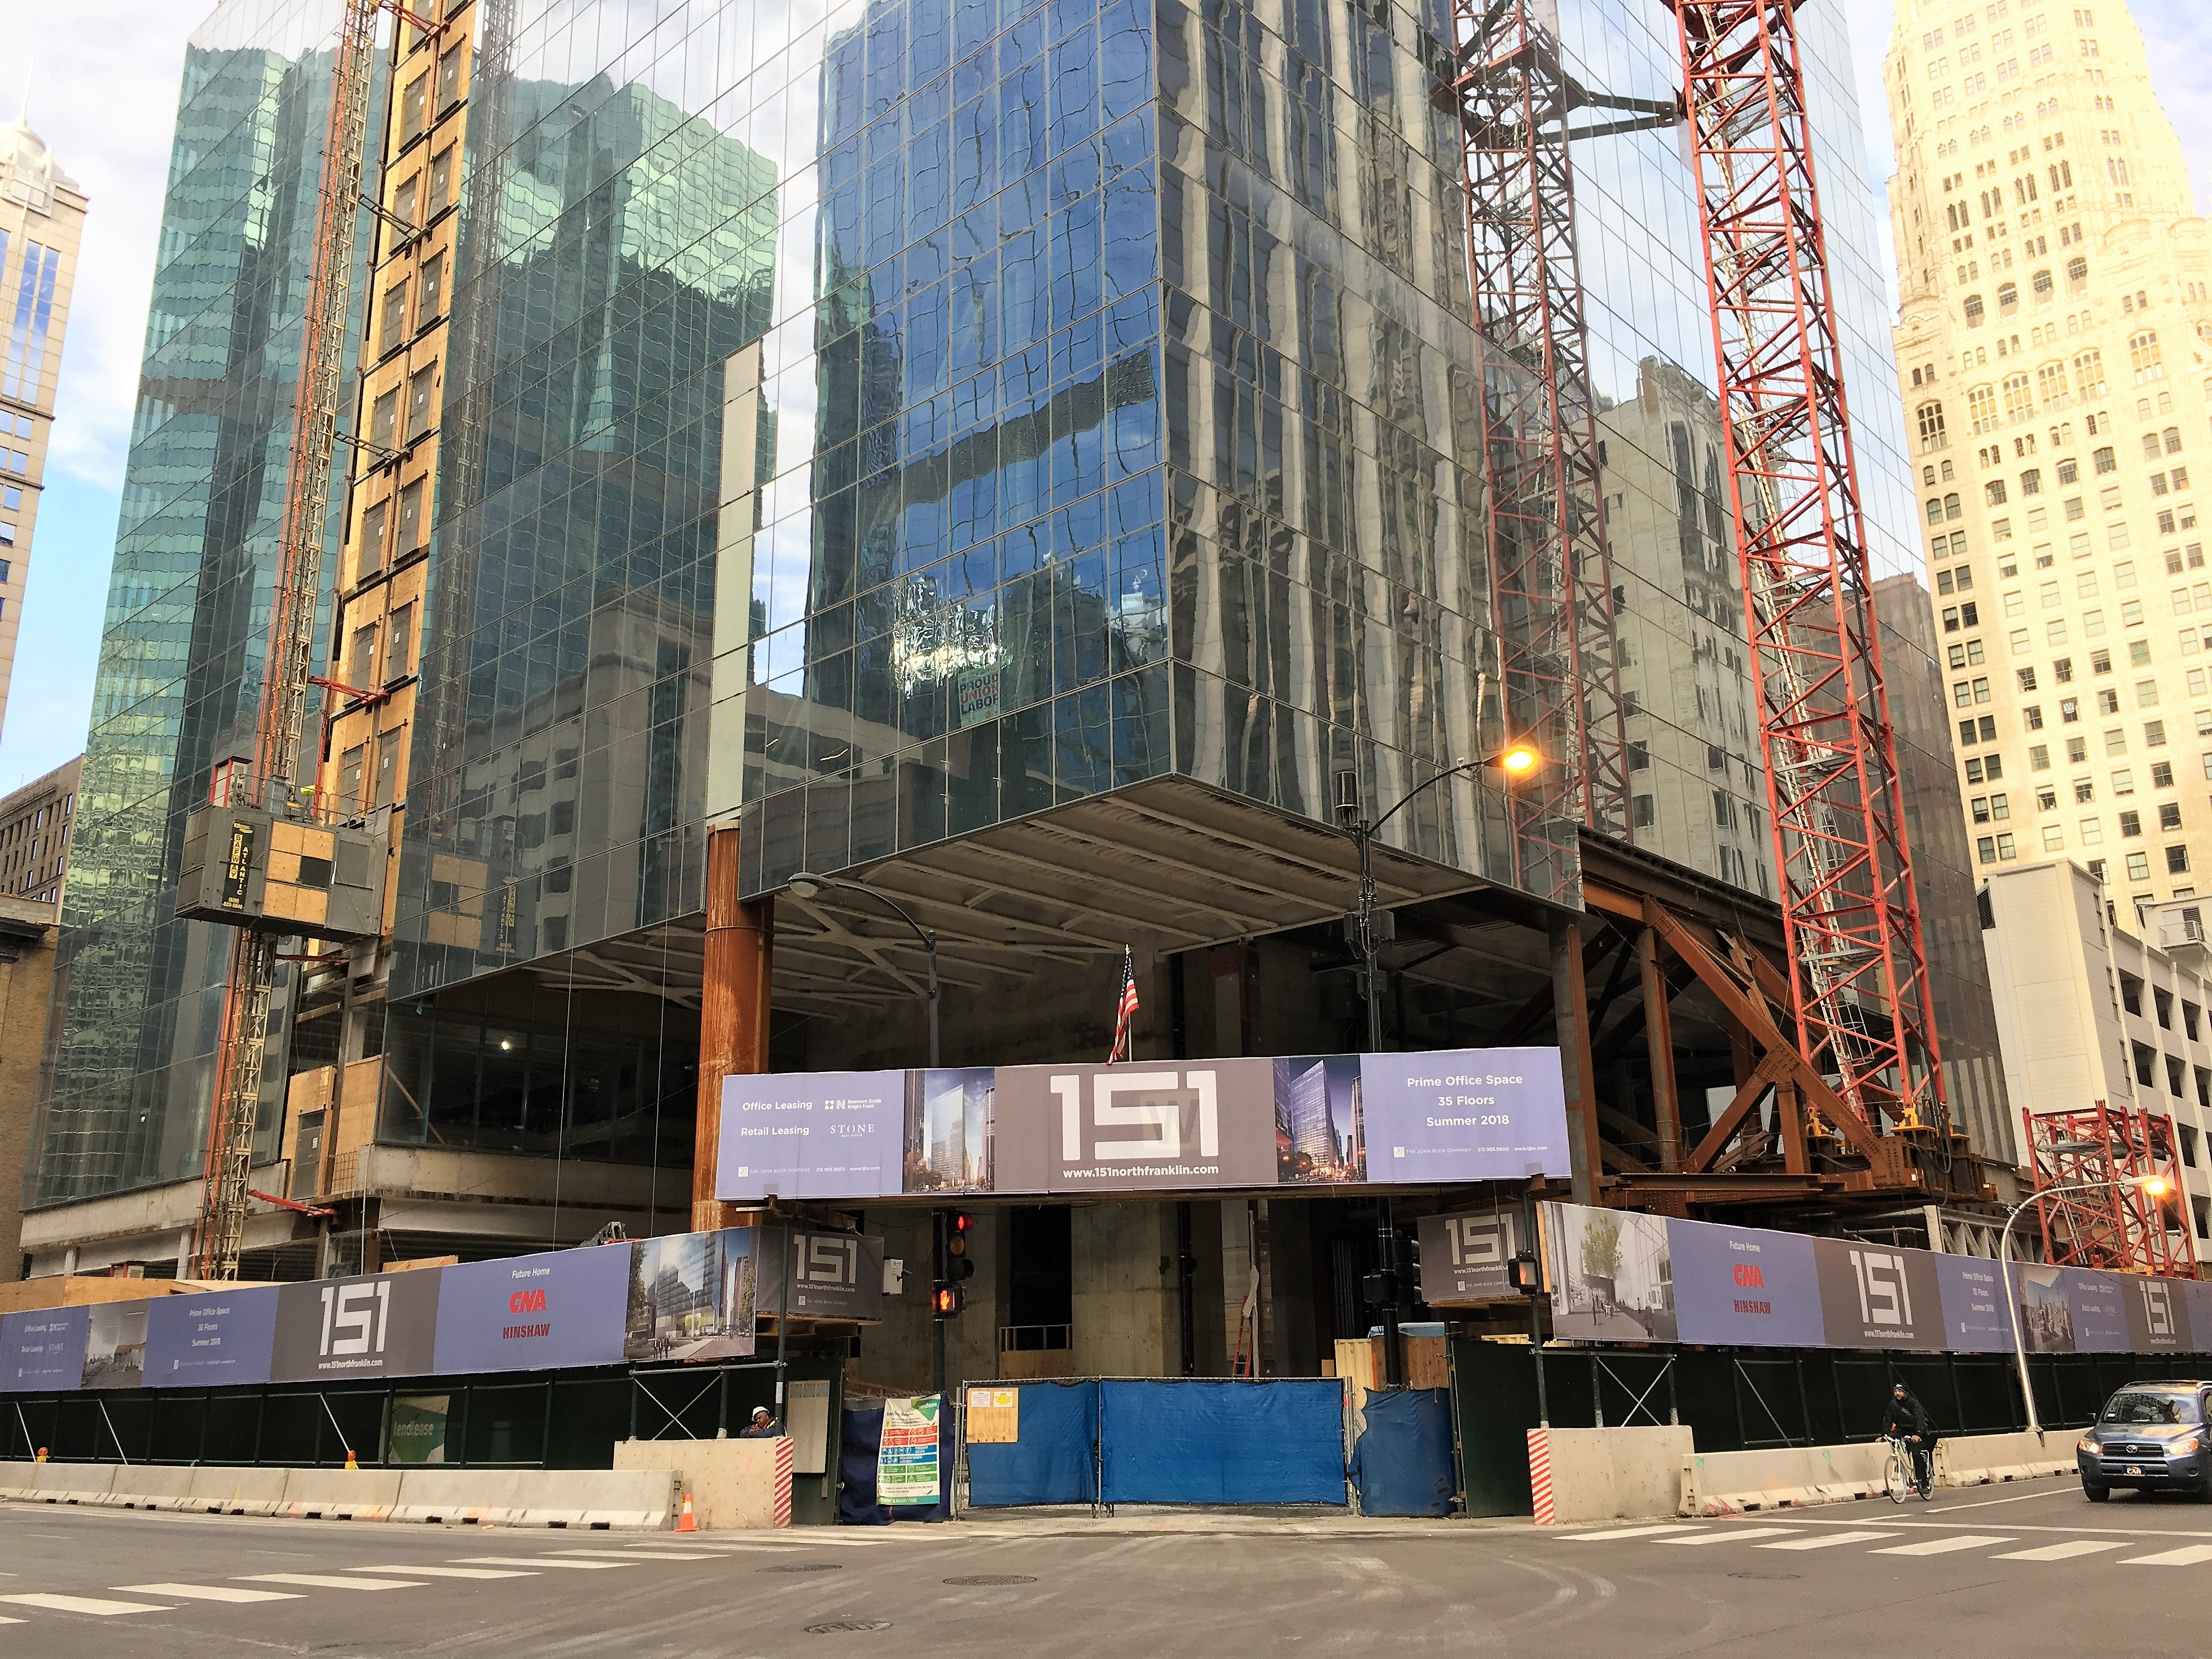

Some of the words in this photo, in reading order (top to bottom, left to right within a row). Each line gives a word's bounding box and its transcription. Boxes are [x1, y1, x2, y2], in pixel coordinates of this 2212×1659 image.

[960, 673, 998, 693] PROUD
[961, 682, 998, 703] UNION
[230, 834, 242, 879] SAFWAY
[237, 847, 249, 895] ATLANTIC
[1407, 1077, 1442, 1087] Prime
[1446, 1076, 1482, 1086] Office
[1486, 1075, 1523, 1086] Space
[742, 1102, 772, 1111] Office
[775, 1101, 812, 1110] Leasing
[1438, 1096, 1453, 1106] 35
[1457, 1096, 1495, 1105] Floors
[1050, 1070, 1219, 1161] 151
[1426, 1117, 1477, 1127] Summer
[1481, 1115, 1509, 1125] 2018
[741, 1127, 769, 1136] Retail
[772, 1126, 809, 1136] Leasing
[830, 1124, 874, 1133] STONE
[1063, 1164, 1219, 1178] www.151northfranklin.com
[1445, 1213, 1516, 1265] 151
[1729, 1240, 1745, 1251] Future
[1746, 1243, 1760, 1252] Home
[794, 1234, 857, 1284] 151
[511, 1269, 531, 1279] Future
[532, 1268, 550, 1277] Home
[1454, 1265, 1509, 1274] www.151northfranklin.c
[1734, 1263, 1765, 1289] CNA
[1849, 1250, 1912, 1325] 151
[509, 1289, 546, 1314] CNA
[1734, 1299, 1771, 1314] HINSHAW
[2139, 1281, 2175, 1335] 151
[320, 1280, 391, 1356] 151
[503, 1323, 550, 1339] HINSHAW
[318, 1358, 383, 1369] www.151northfranklin.com
